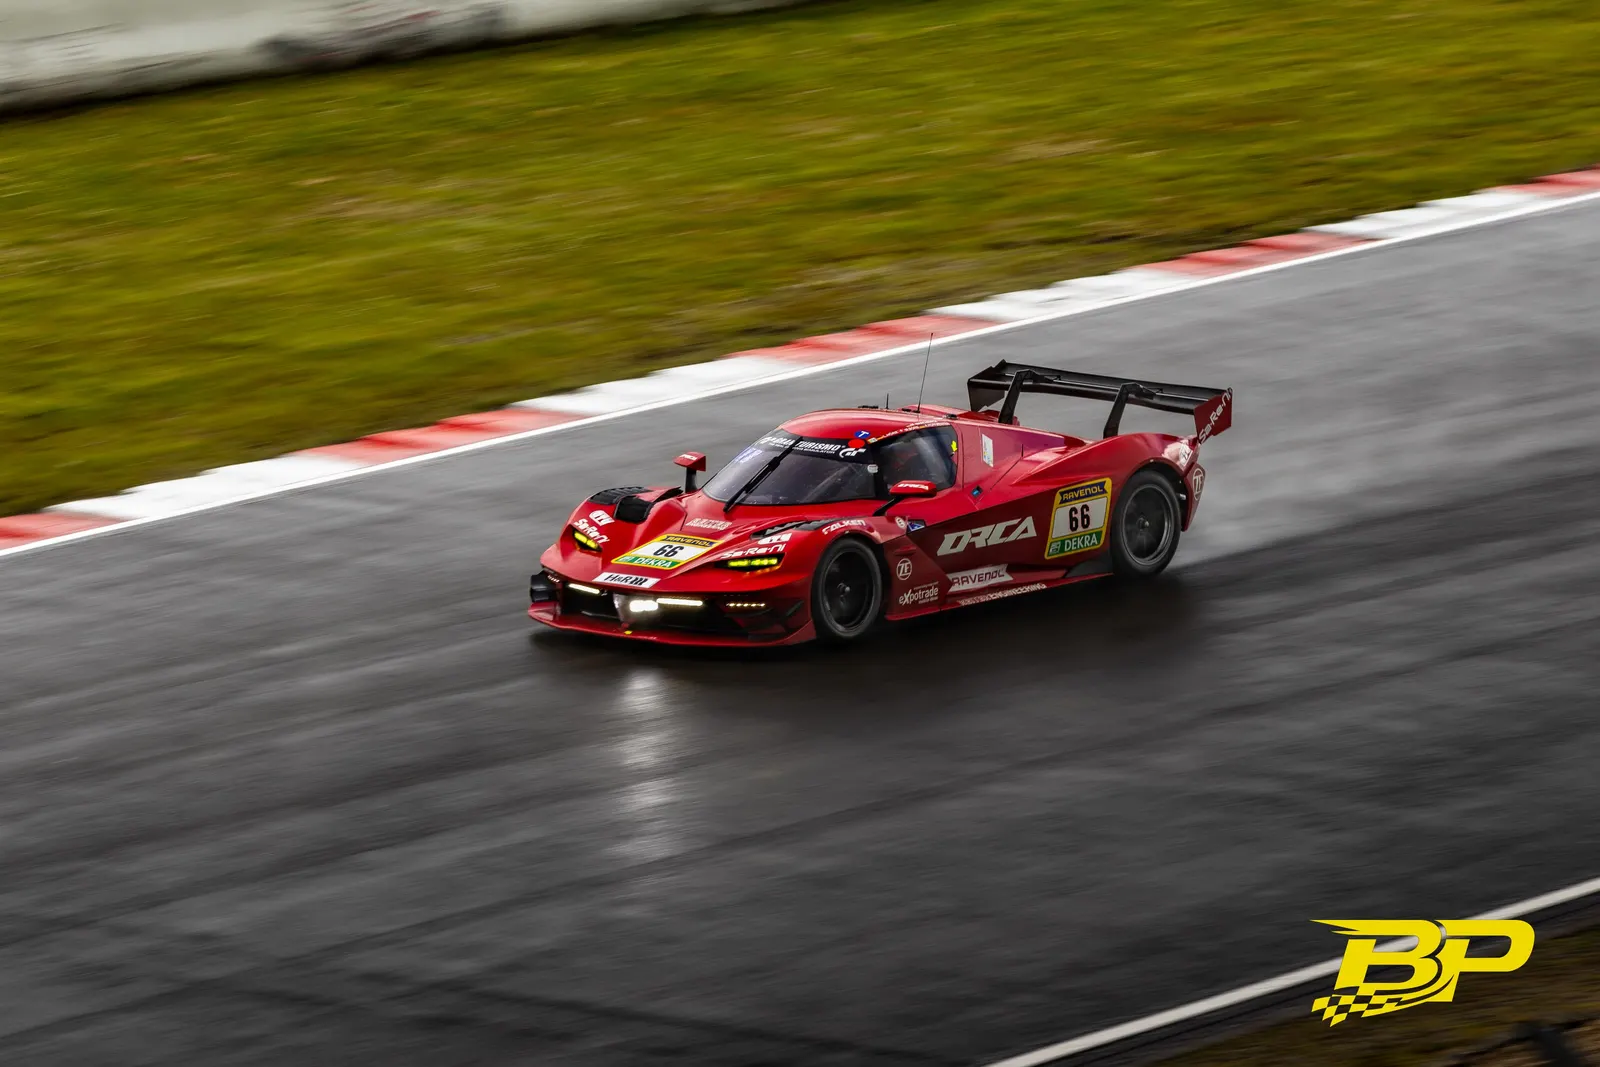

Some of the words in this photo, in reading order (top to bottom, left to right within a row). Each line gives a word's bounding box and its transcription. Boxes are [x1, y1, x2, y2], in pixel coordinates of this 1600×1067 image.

[1062, 485, 1103, 501] RAVENOL
[1069, 504, 1091, 532] 66
[821, 519, 866, 535] FALKEN
[666, 535, 711, 547] RAVENOL
[1064, 533, 1098, 552] DEKRA
[653, 544, 684, 558] 66
[633, 556, 673, 568] DEKRA
[951, 568, 1005, 587] RAVENOL
